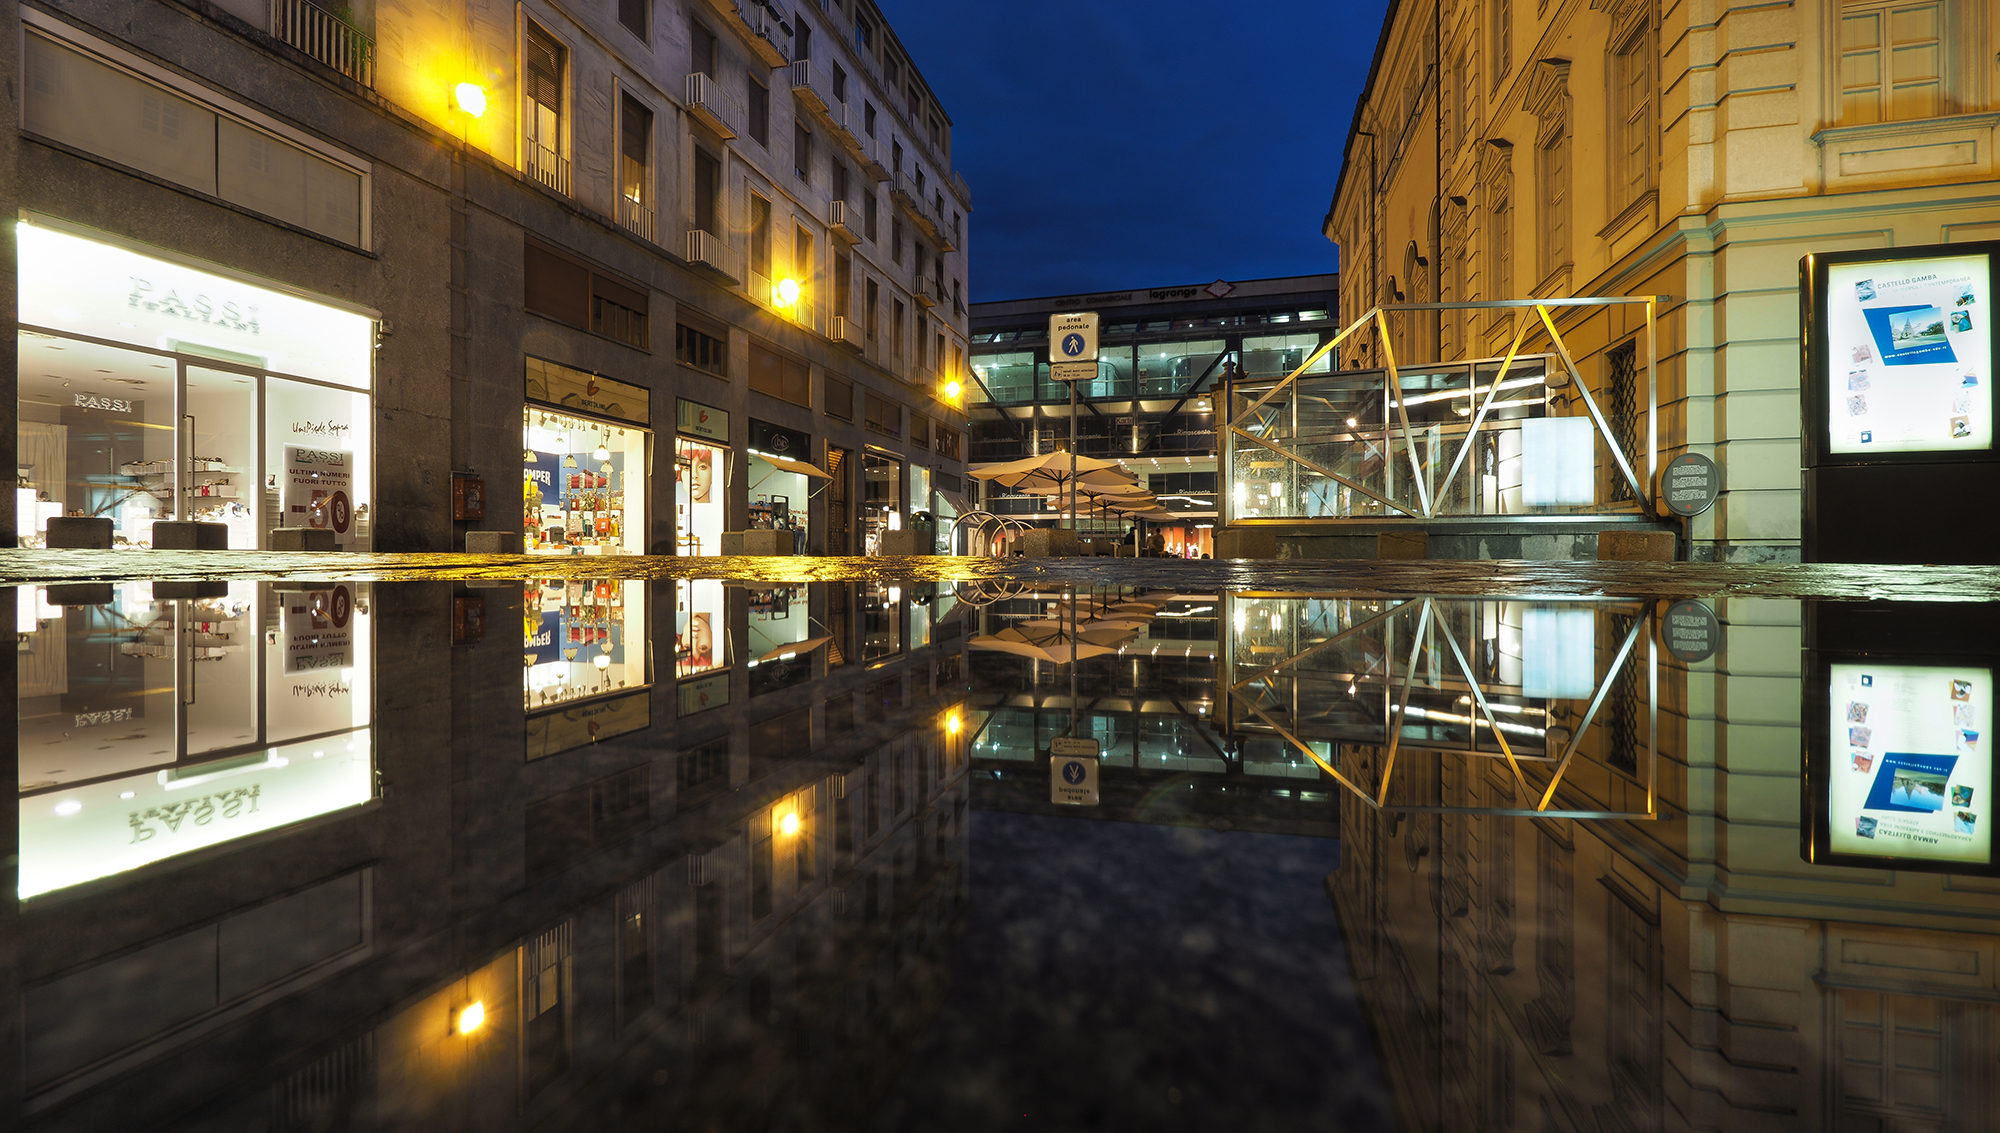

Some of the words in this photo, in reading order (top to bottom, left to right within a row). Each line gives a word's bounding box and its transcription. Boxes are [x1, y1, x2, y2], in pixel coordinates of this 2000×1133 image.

[1877, 278, 1910, 289] CASTELLO
[1911, 274, 1938, 283] GAMBA
[129, 275, 260, 326] PASSI
[1055, 298, 1081, 307] CENTRO
[1086, 293, 1133, 304] COMMERCIALE
[1150, 288, 1198, 300] lagrange
[1057, 323, 1090, 331] pedonale
[75, 393, 132, 410] PASSI
[295, 448, 344, 461] PASSI
[289, 468, 318, 476] ULTIMI
[320, 471, 350, 479] NUMERI
[293, 477, 319, 485] FUORI
[321, 479, 347, 487] TUTTO
